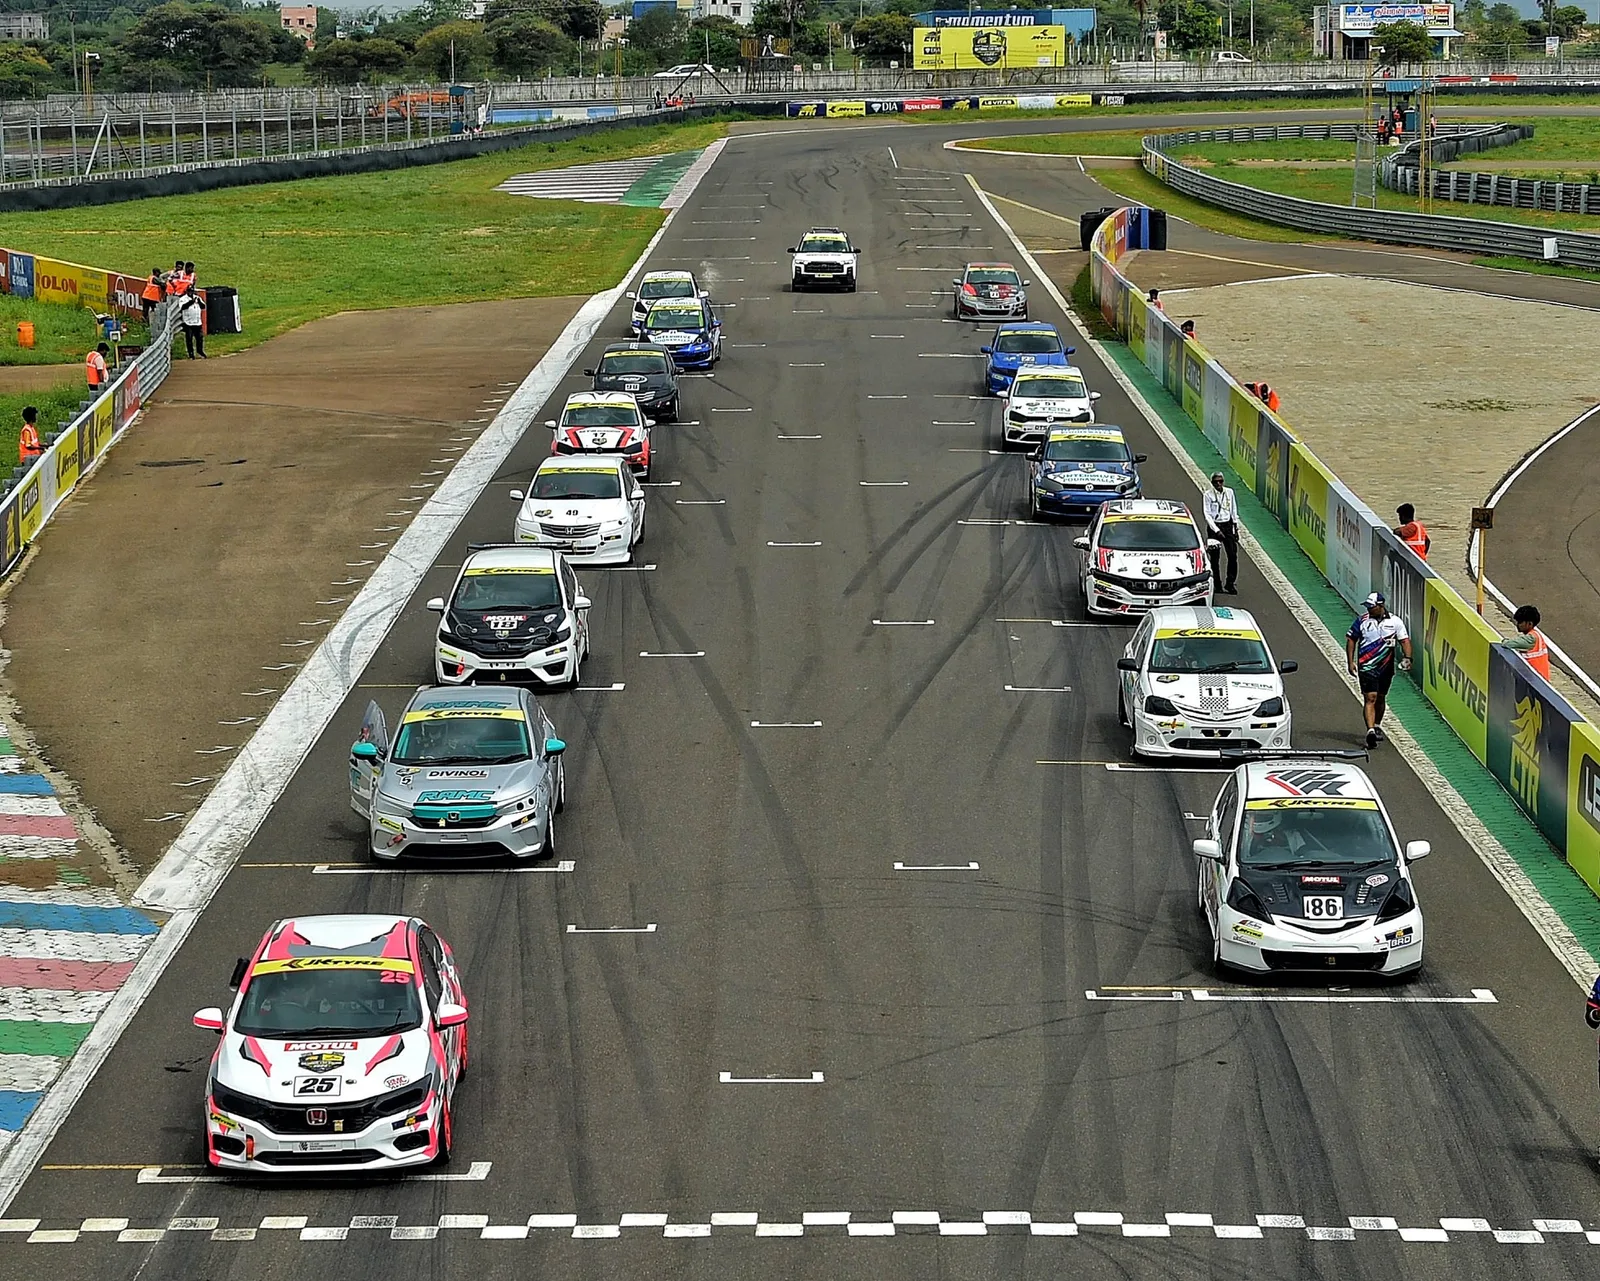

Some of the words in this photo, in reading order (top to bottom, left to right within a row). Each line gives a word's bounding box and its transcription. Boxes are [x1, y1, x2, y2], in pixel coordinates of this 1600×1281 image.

[948, 14, 1034, 26] momentum
[882, 102, 898, 112] DIA
[117, 290, 143, 310] ROL
[1393, 560, 1411, 636] DIA
[1205, 687, 1224, 696] 11
[418, 790, 496, 801] RAMC
[1311, 898, 1337, 916] 86
[380, 970, 410, 984] 25
[288, 1042, 354, 1050] MOTUL
[298, 1078, 337, 1093] 25
